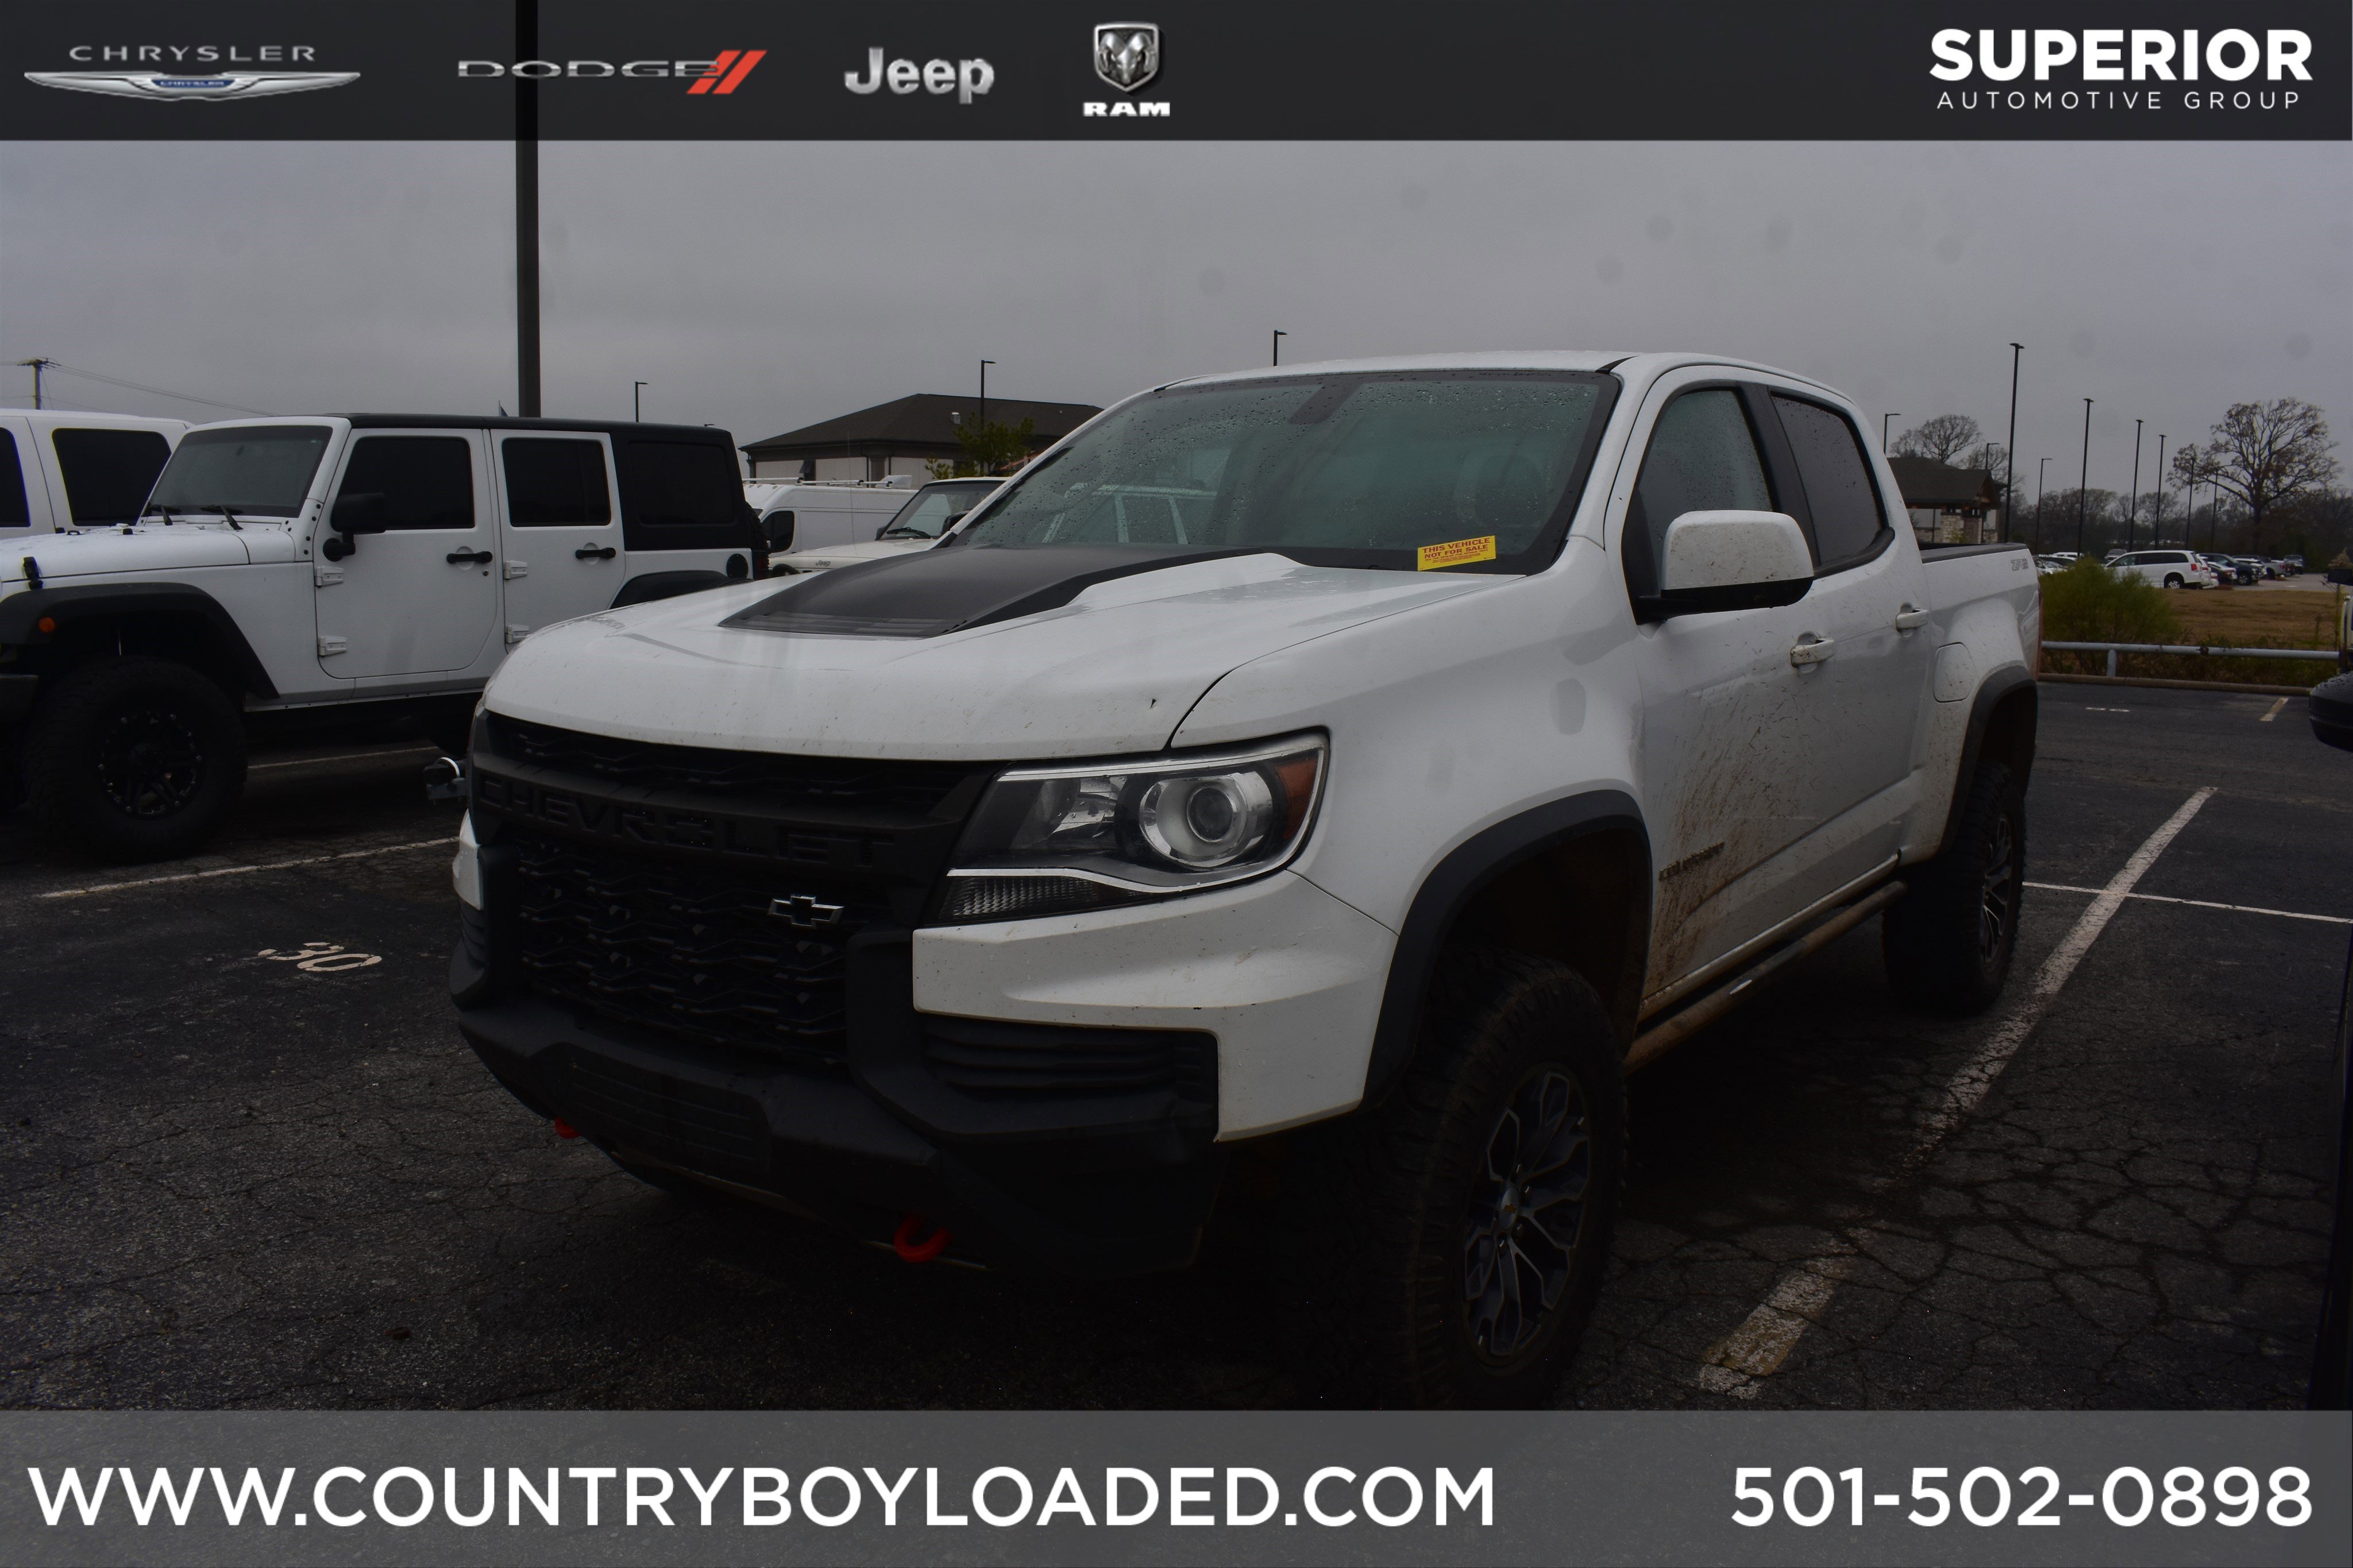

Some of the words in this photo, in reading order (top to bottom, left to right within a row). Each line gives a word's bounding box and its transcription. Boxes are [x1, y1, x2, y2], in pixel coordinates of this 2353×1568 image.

[1422, 545, 1445, 554] THIS
[1448, 538, 1491, 549] VEHICLE
[480, 775, 896, 868] CHEVROLET
